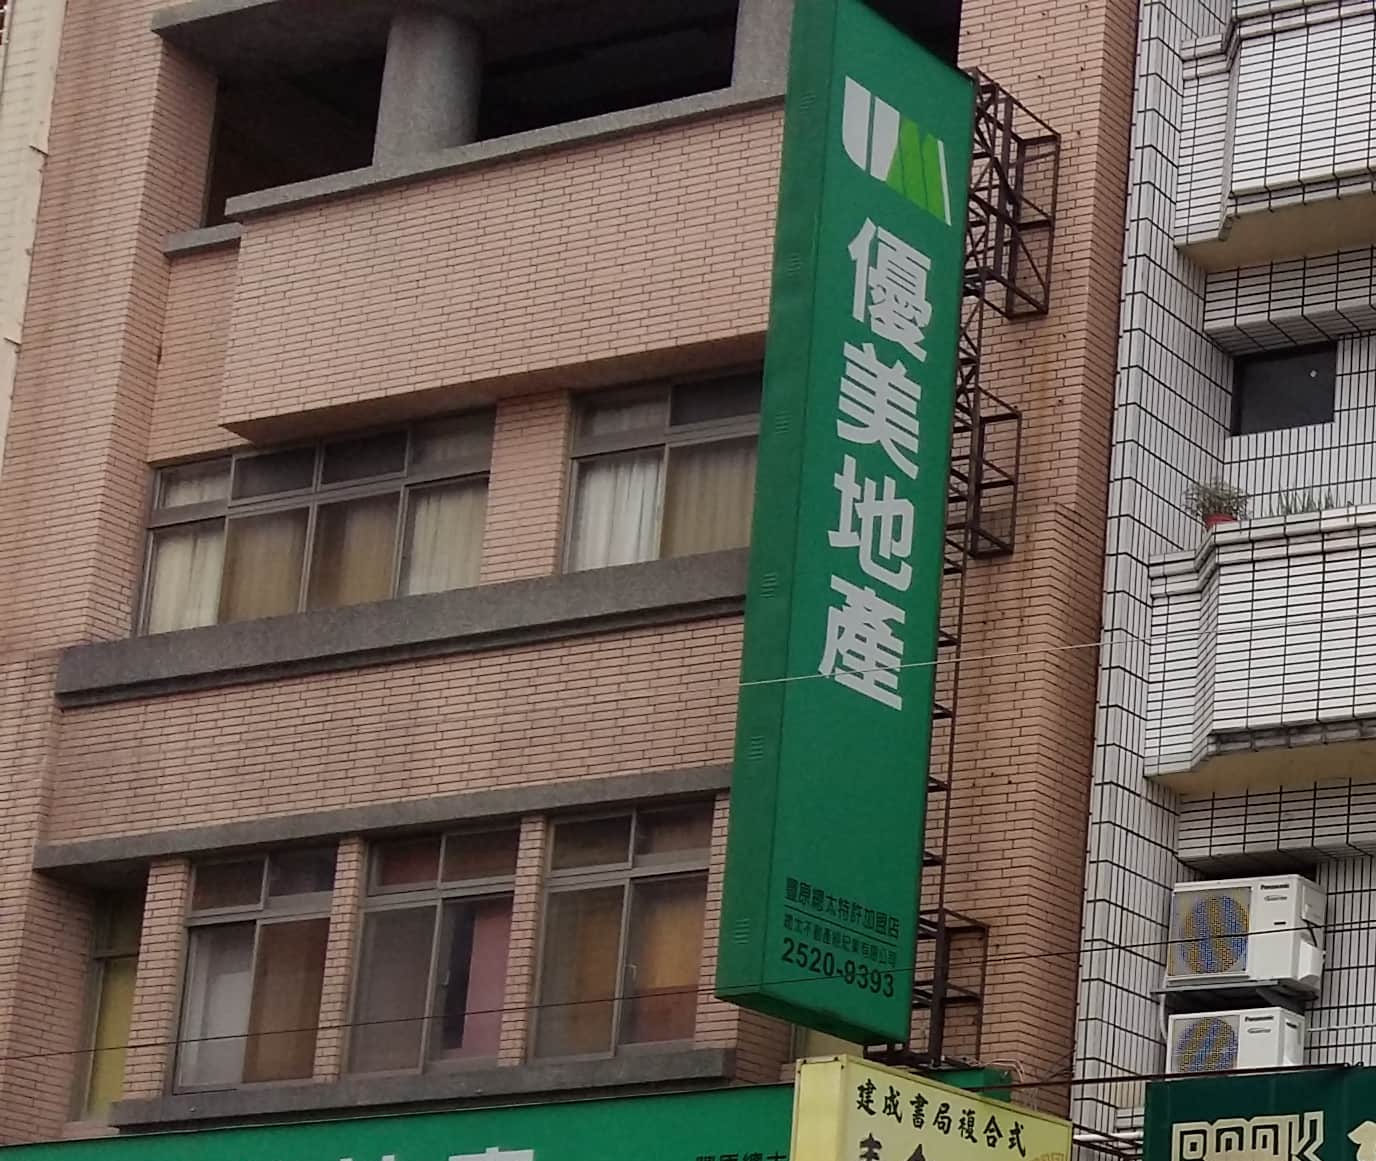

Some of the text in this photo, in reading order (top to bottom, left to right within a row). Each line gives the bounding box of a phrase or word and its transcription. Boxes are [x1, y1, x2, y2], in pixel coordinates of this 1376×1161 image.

[818, 217, 932, 711] 優美地產
[782, 937, 894, 998] 2520-9393
[856, 1078, 1027, 1158] 建成書局複合式
